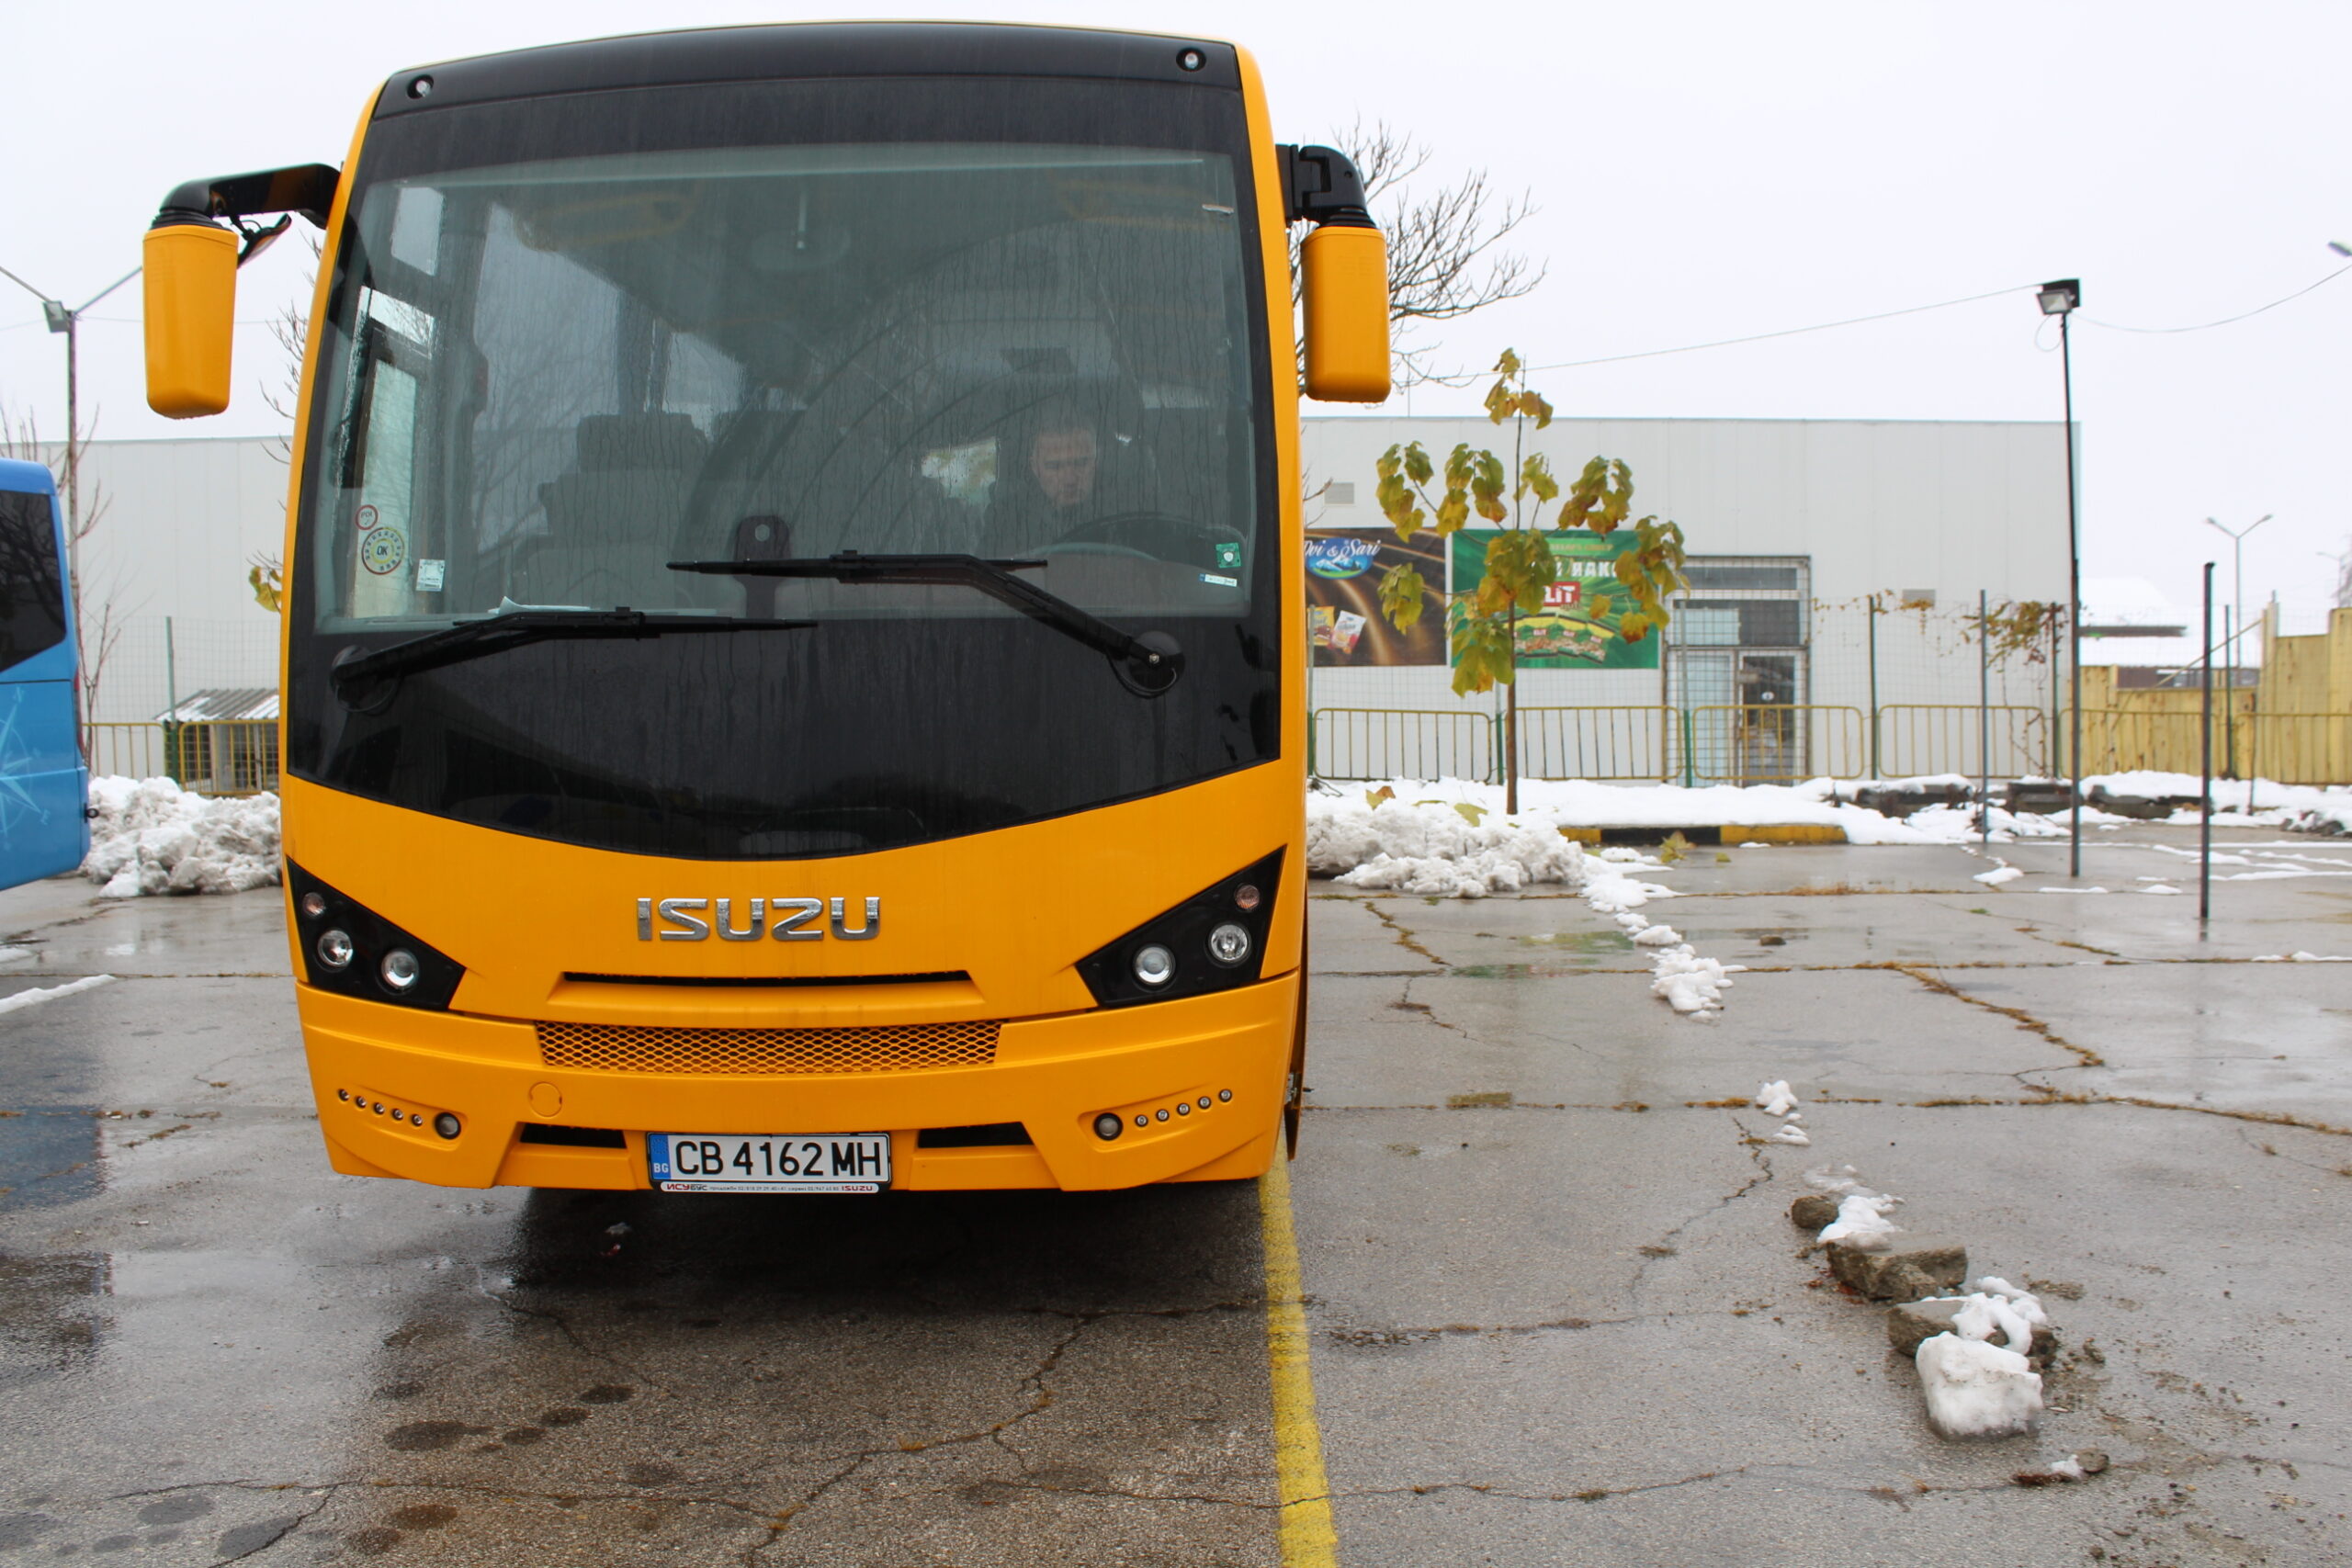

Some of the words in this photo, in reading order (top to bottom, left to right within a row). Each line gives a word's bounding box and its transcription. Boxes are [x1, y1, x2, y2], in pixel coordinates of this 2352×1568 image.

[377, 545, 389, 556] OK
[1340, 538, 1382, 558] Sari
[1543, 585, 1576, 603] LIT
[637, 897, 881, 942] ISUZU
[653, 1163, 669, 1173] BG
[675, 1141, 724, 1175] CB
[732, 1142, 824, 1176] 4162
[831, 1142, 882, 1177] MH
